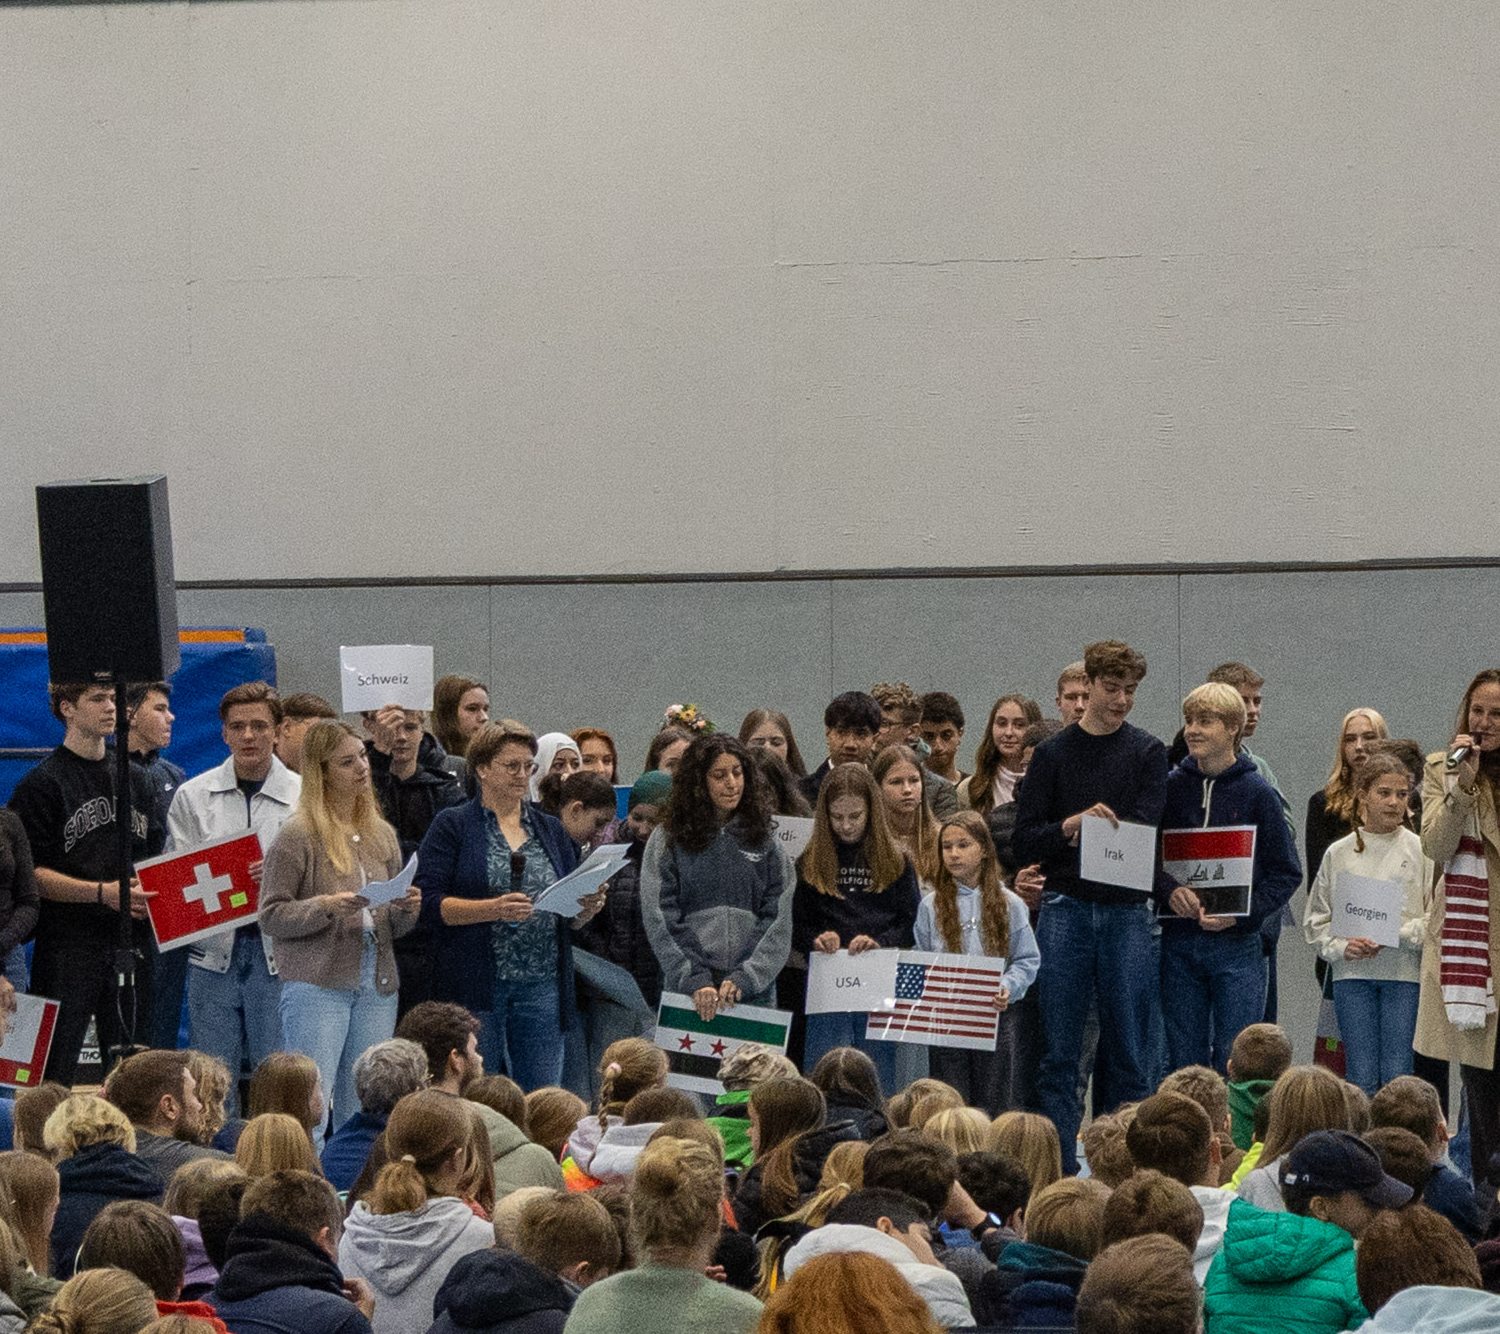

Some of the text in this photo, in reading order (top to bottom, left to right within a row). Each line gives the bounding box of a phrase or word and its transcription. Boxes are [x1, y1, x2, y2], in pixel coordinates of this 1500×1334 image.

[357, 673, 409, 687] Schweiz
[1104, 847, 1125, 862] Irak
[1345, 902, 1388, 921] Georgien
[835, 976, 861, 988] USA
